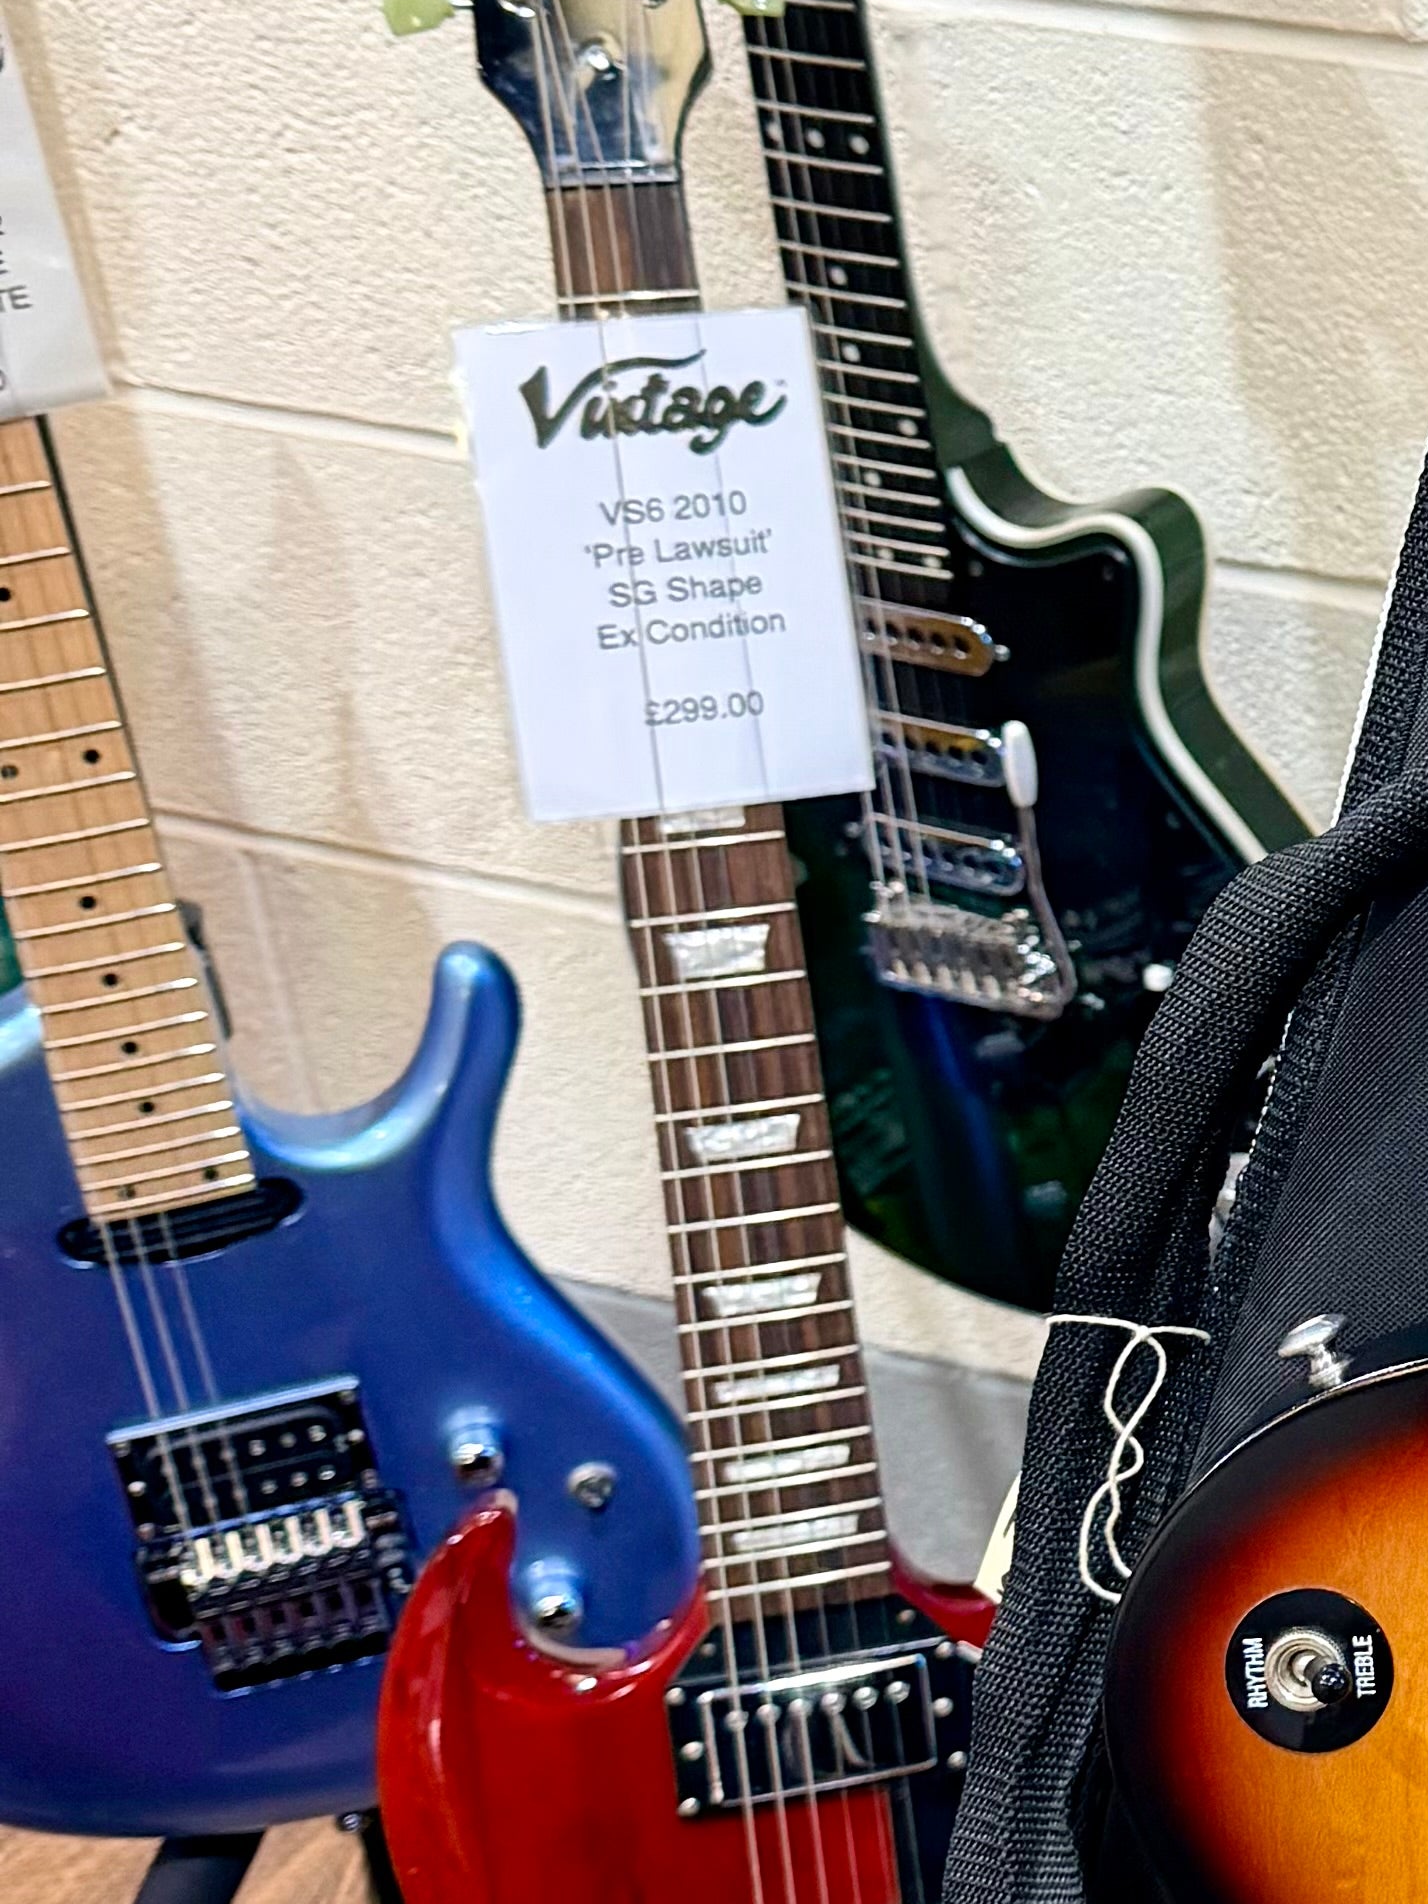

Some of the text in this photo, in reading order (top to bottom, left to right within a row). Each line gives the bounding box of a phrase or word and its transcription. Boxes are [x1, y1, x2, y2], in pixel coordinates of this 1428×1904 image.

[519, 348, 788, 455] Vintage
[599, 490, 747, 527] VS6 2010
[608, 574, 763, 608] SG Shape
[596, 611, 787, 650] Ex Condition
[644, 689, 765, 727] £299.00
[1242, 1638, 1269, 1709] RHYTHM
[1352, 1634, 1376, 1699] TREBLE
